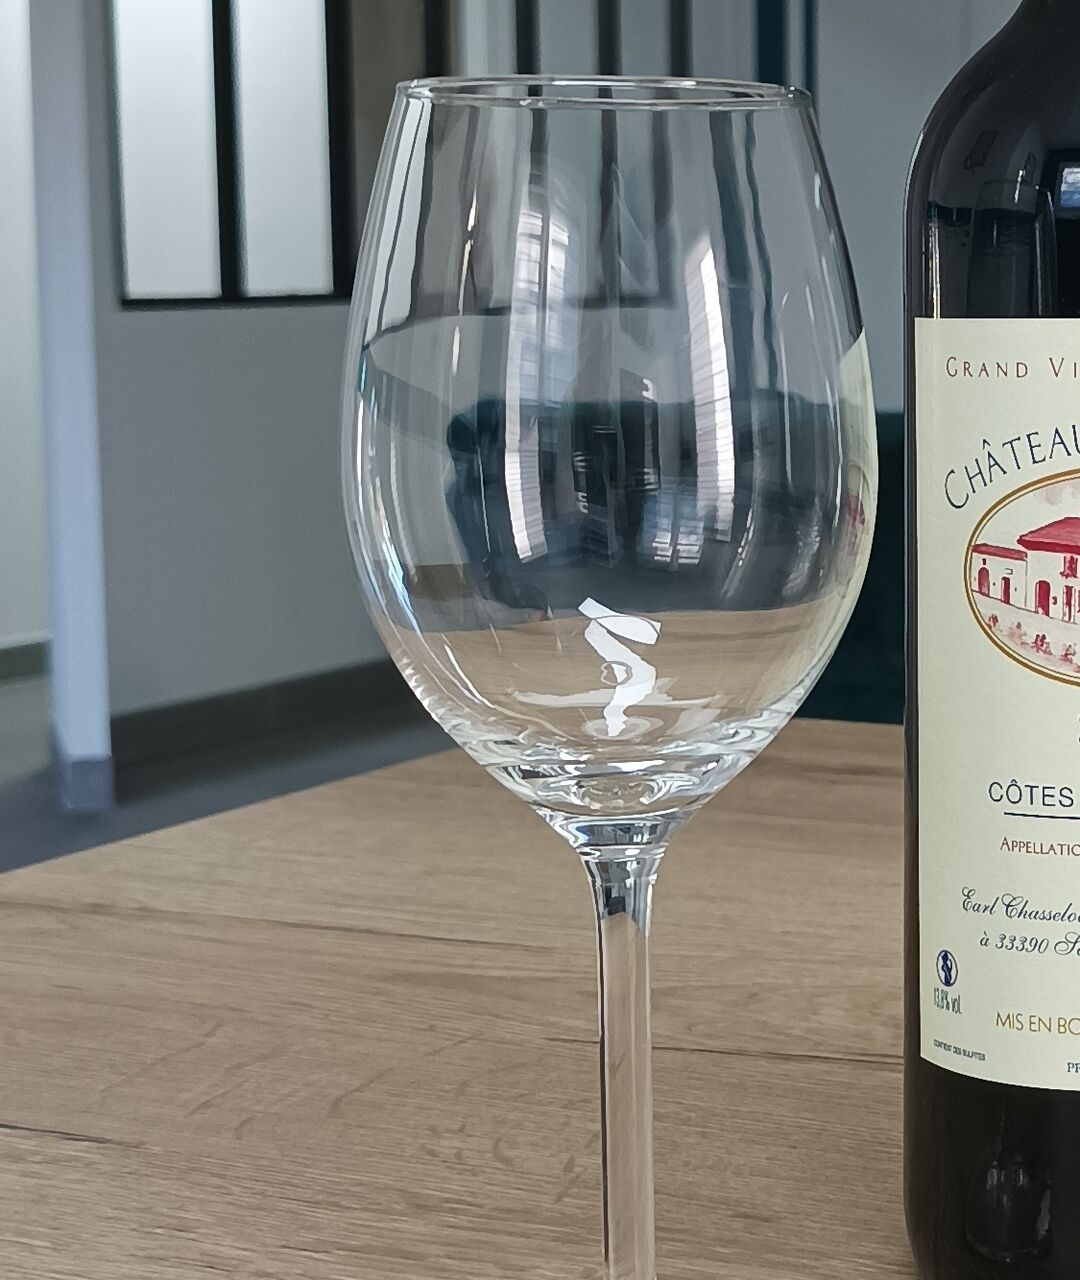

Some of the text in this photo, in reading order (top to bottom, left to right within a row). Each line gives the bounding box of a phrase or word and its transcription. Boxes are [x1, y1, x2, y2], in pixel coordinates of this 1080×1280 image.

[945, 356, 1029, 379] GRAND
[988, 779, 1075, 808] CÔTES
[961, 886, 1000, 916] Earl
[979, 930, 990, 947] à
[995, 933, 1050, 954] 33390
[995, 1011, 1025, 1032] MIS
[1030, 1016, 1052, 1034] EN
